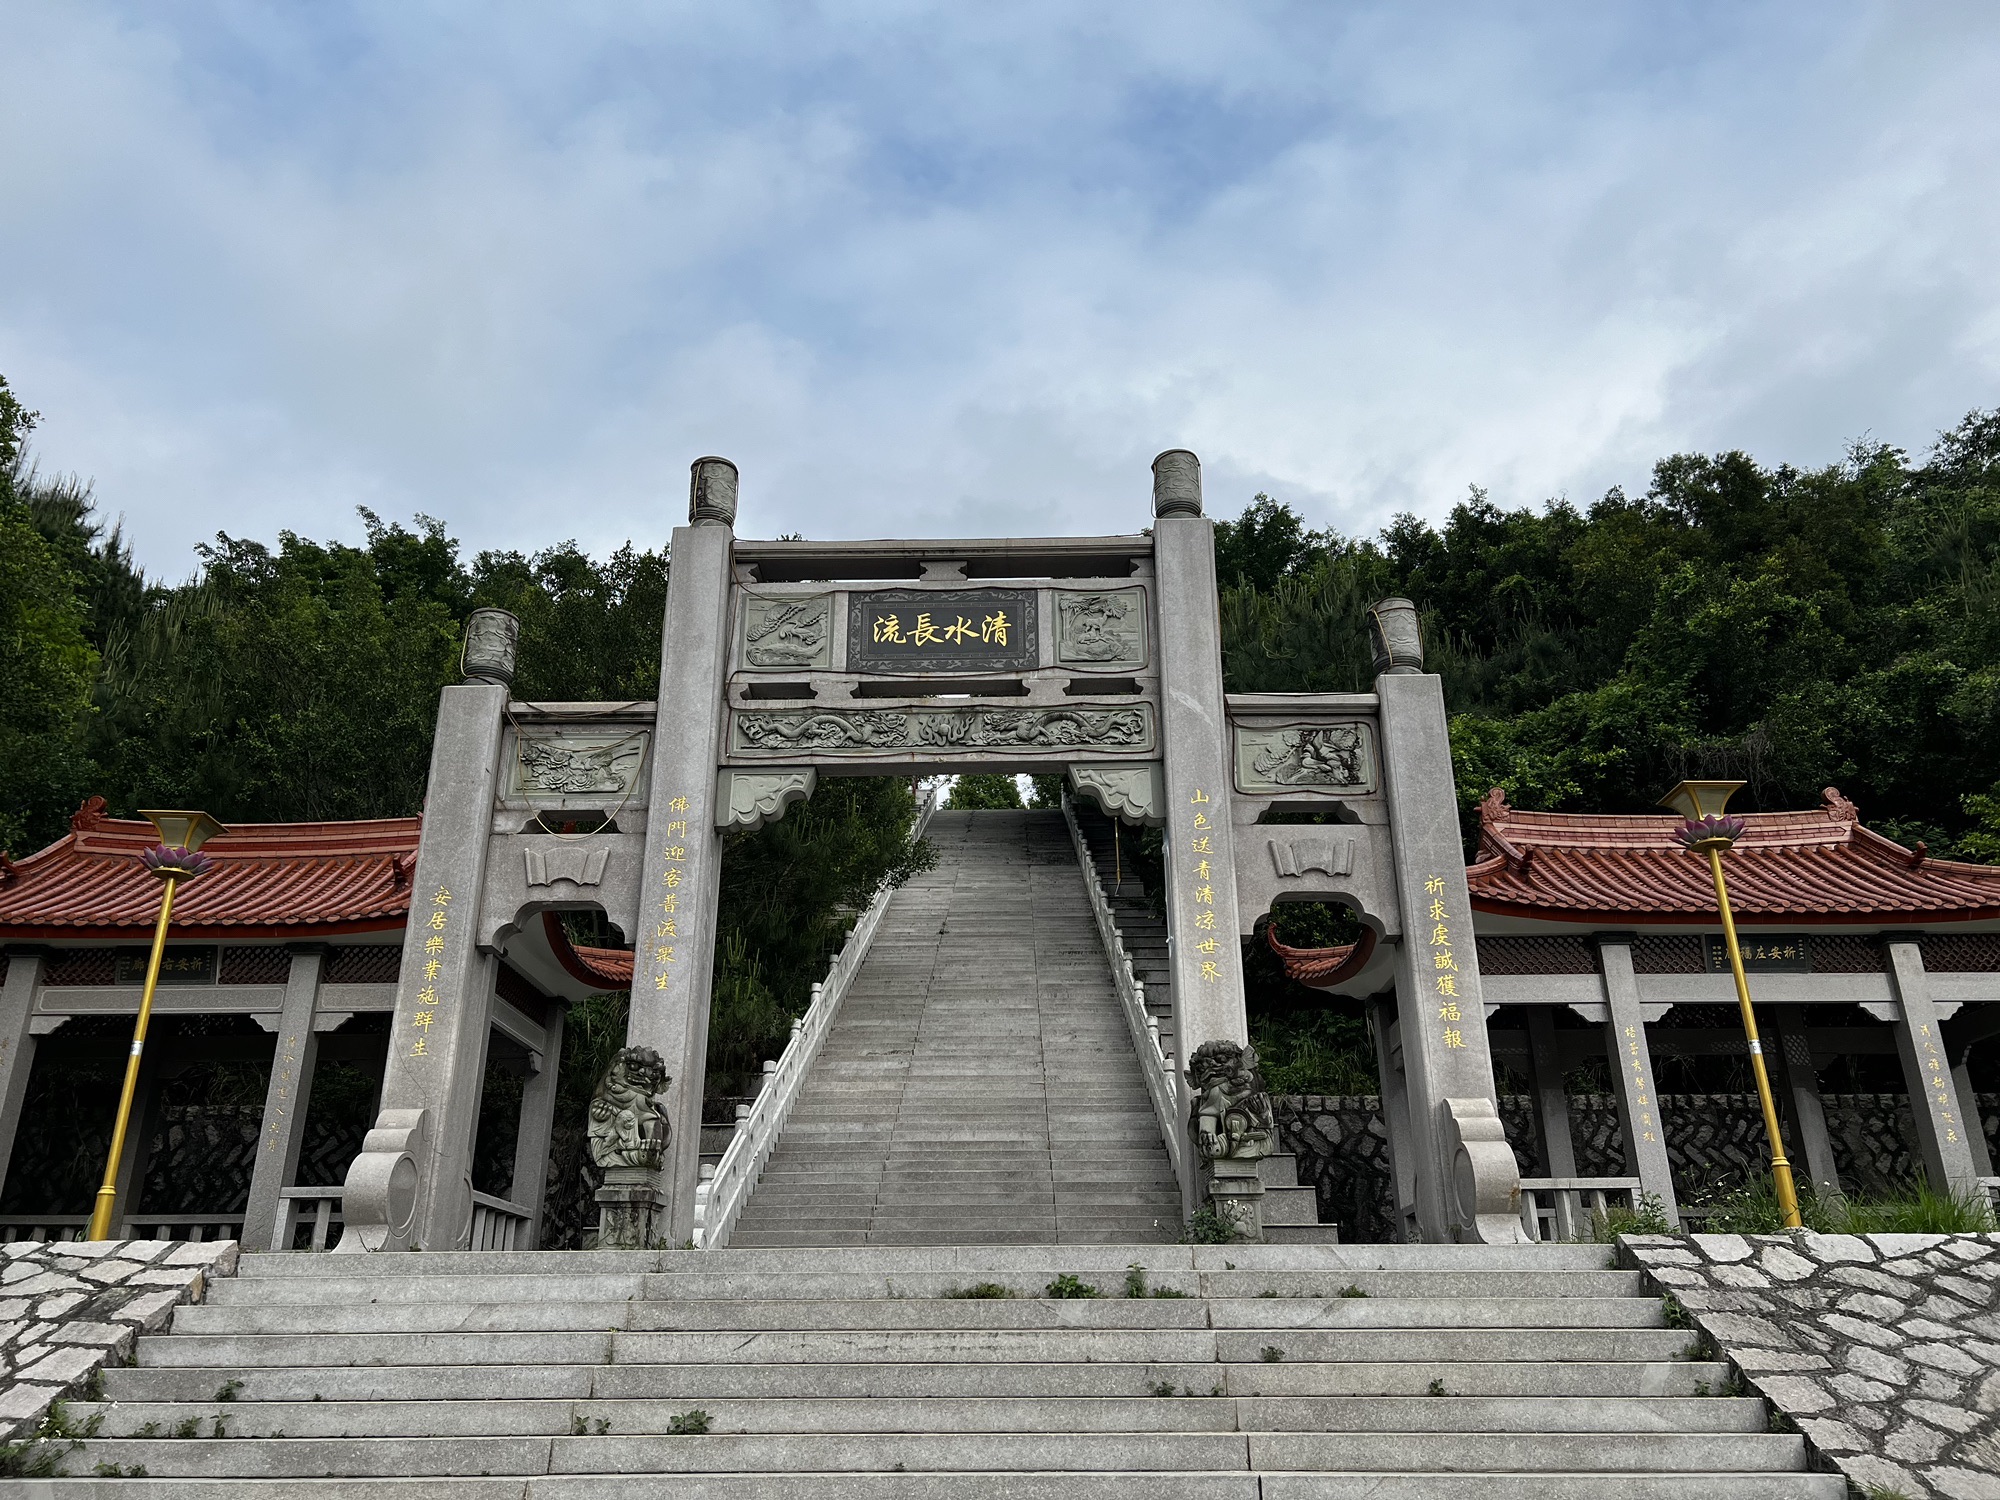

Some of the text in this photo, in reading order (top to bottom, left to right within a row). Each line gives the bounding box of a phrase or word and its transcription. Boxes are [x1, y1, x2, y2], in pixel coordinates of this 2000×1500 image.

[873, 610, 1012, 647] 清水長流
[1424, 874, 1467, 1048] 祈求虔誠獲福報
